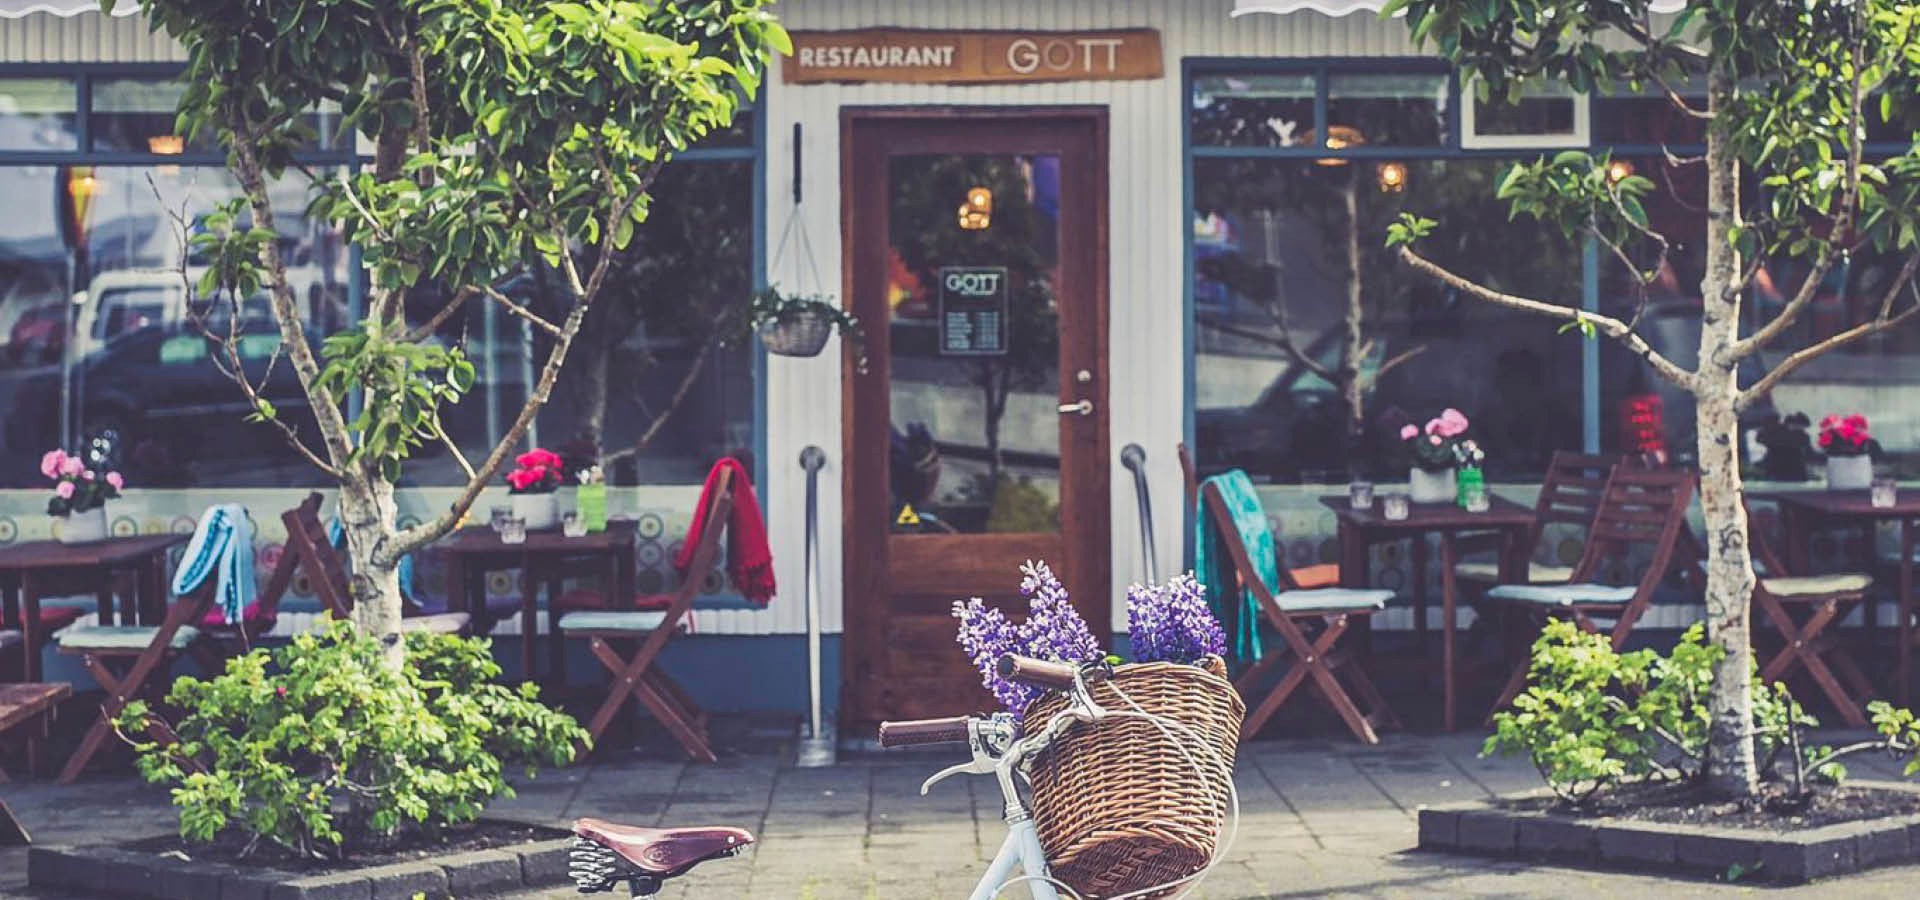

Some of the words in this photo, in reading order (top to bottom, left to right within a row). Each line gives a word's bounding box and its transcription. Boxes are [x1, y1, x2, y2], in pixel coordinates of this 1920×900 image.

[799, 46, 955, 67] RESTAURANT
[1007, 38, 1124, 73] GOTT
[946, 273, 1000, 291] GOTT
